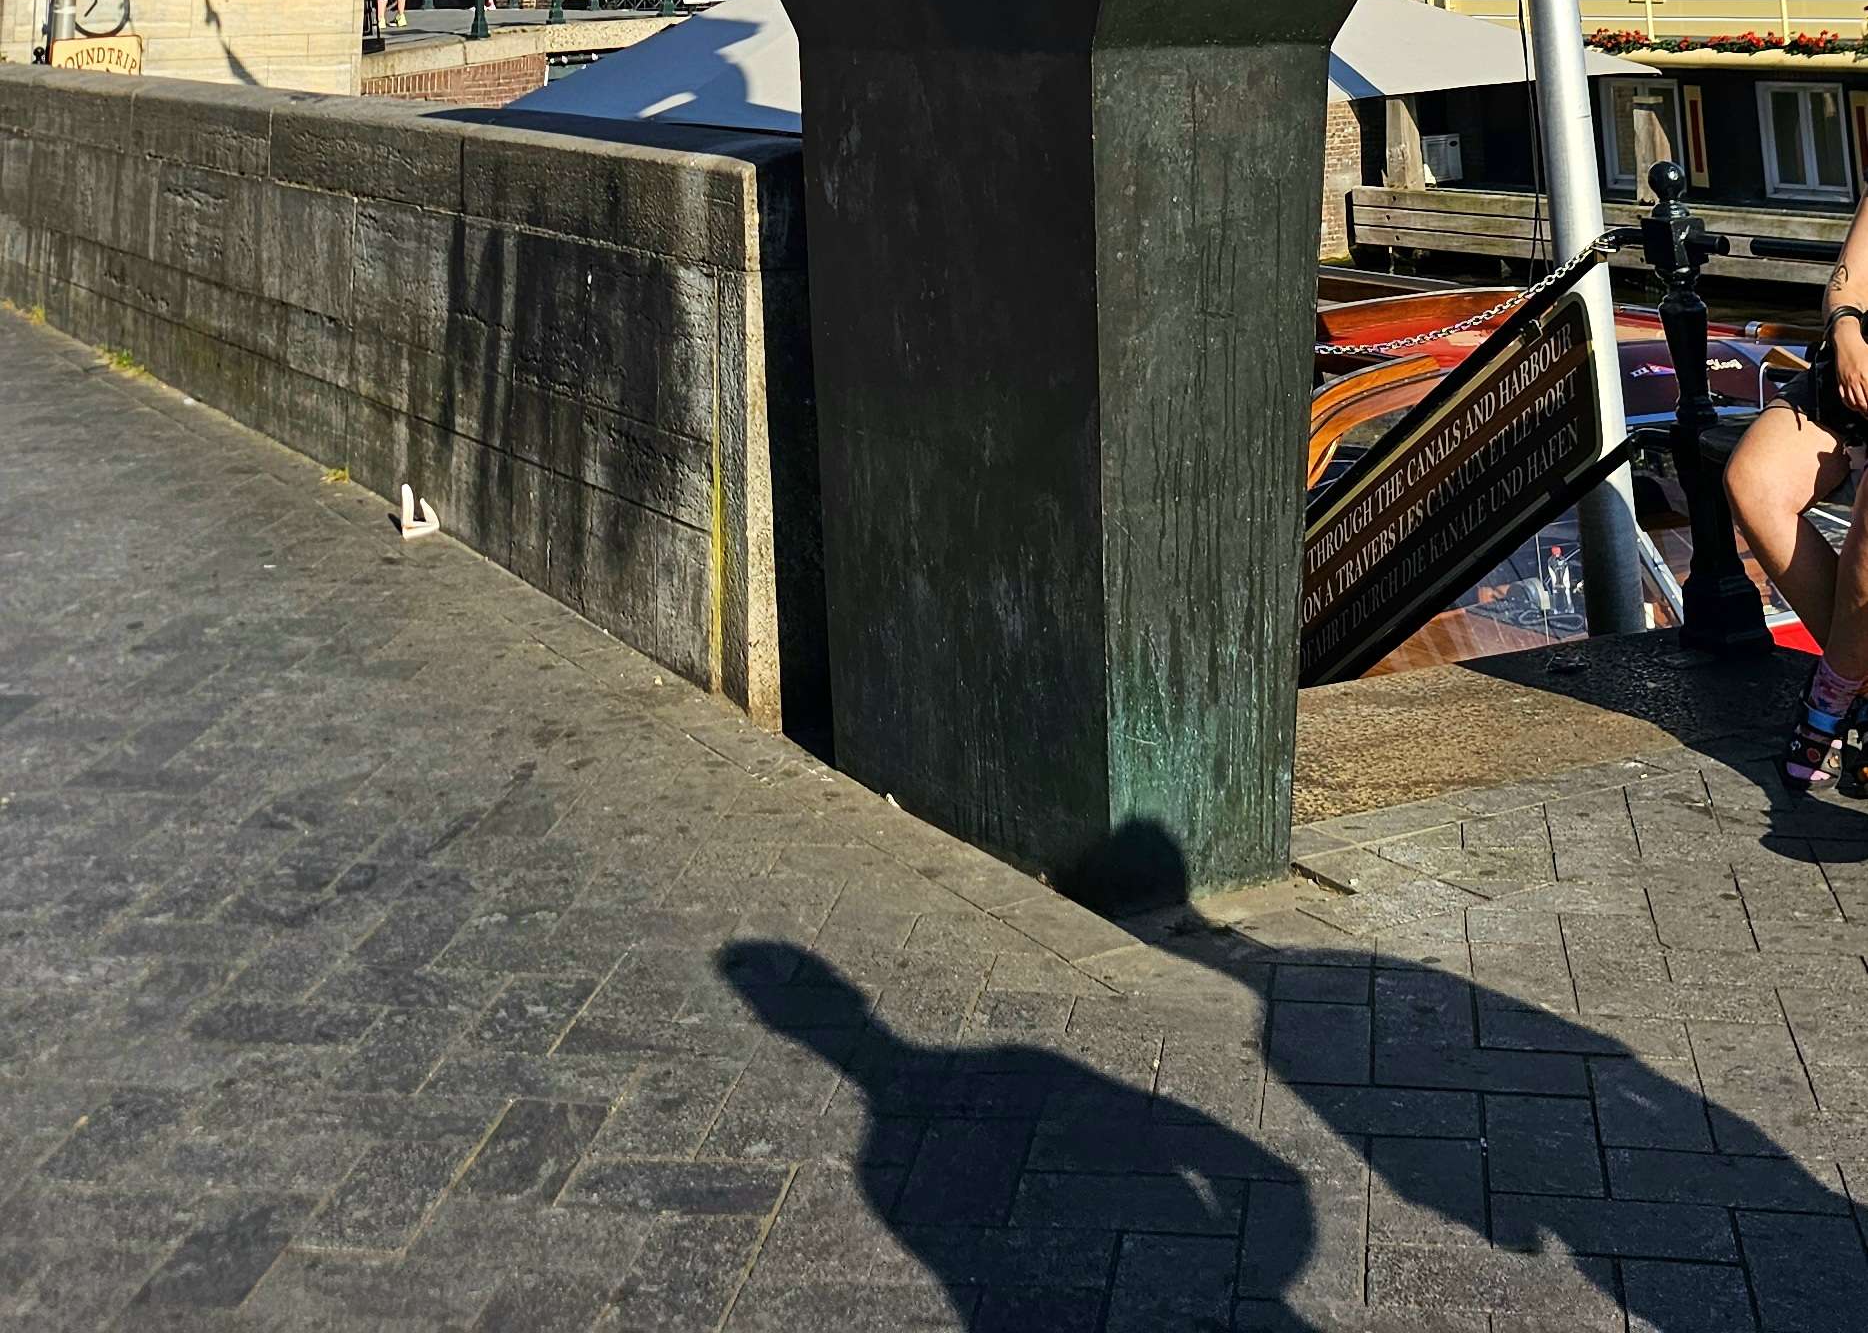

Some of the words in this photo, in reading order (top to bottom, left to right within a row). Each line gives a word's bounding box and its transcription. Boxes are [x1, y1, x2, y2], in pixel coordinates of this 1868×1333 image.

[57, 47, 138, 76] OUNDTRIP
[1306, 499, 1373, 574] THROUGH
[1374, 468, 1405, 515] THE
[1406, 418, 1462, 487] CANALS
[1463, 390, 1496, 441] AND
[1498, 322, 1573, 410] HARBOUR
[1324, 583, 1334, 608] A
[1335, 526, 1397, 594] TRAVERS
[1398, 498, 1425, 544] LES
[1426, 445, 1487, 519] CANAUX
[1488, 423, 1511, 468] ET
[1512, 406, 1533, 447] LE
[1535, 367, 1578, 428] PORT
[1351, 566, 1399, 630] DURCH
[1401, 543, 1428, 587] DIE
[1489, 465, 1524, 513] UND
[1526, 416, 1581, 485] HAFEN
